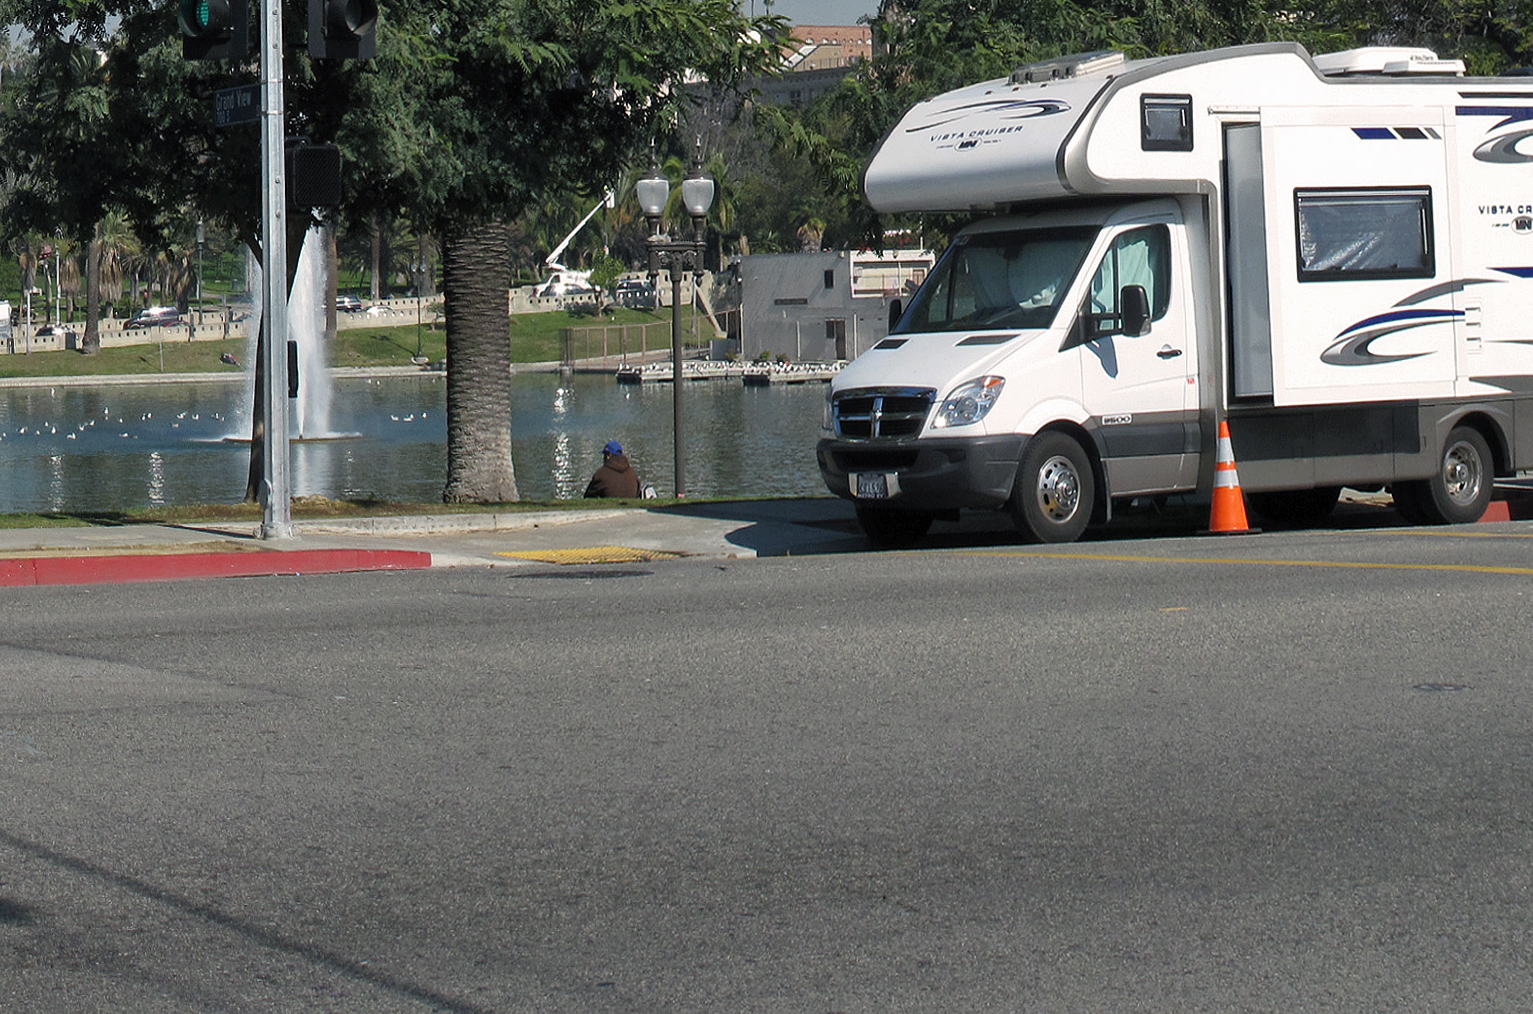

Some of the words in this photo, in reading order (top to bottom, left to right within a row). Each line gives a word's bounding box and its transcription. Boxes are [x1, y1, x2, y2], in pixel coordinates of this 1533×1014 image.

[215, 92, 234, 111] Grand
[236, 89, 252, 107] View
[930, 131, 965, 142] VISTA
[969, 125, 1024, 137] CRUISER
[1478, 205, 1513, 214] VISTA
